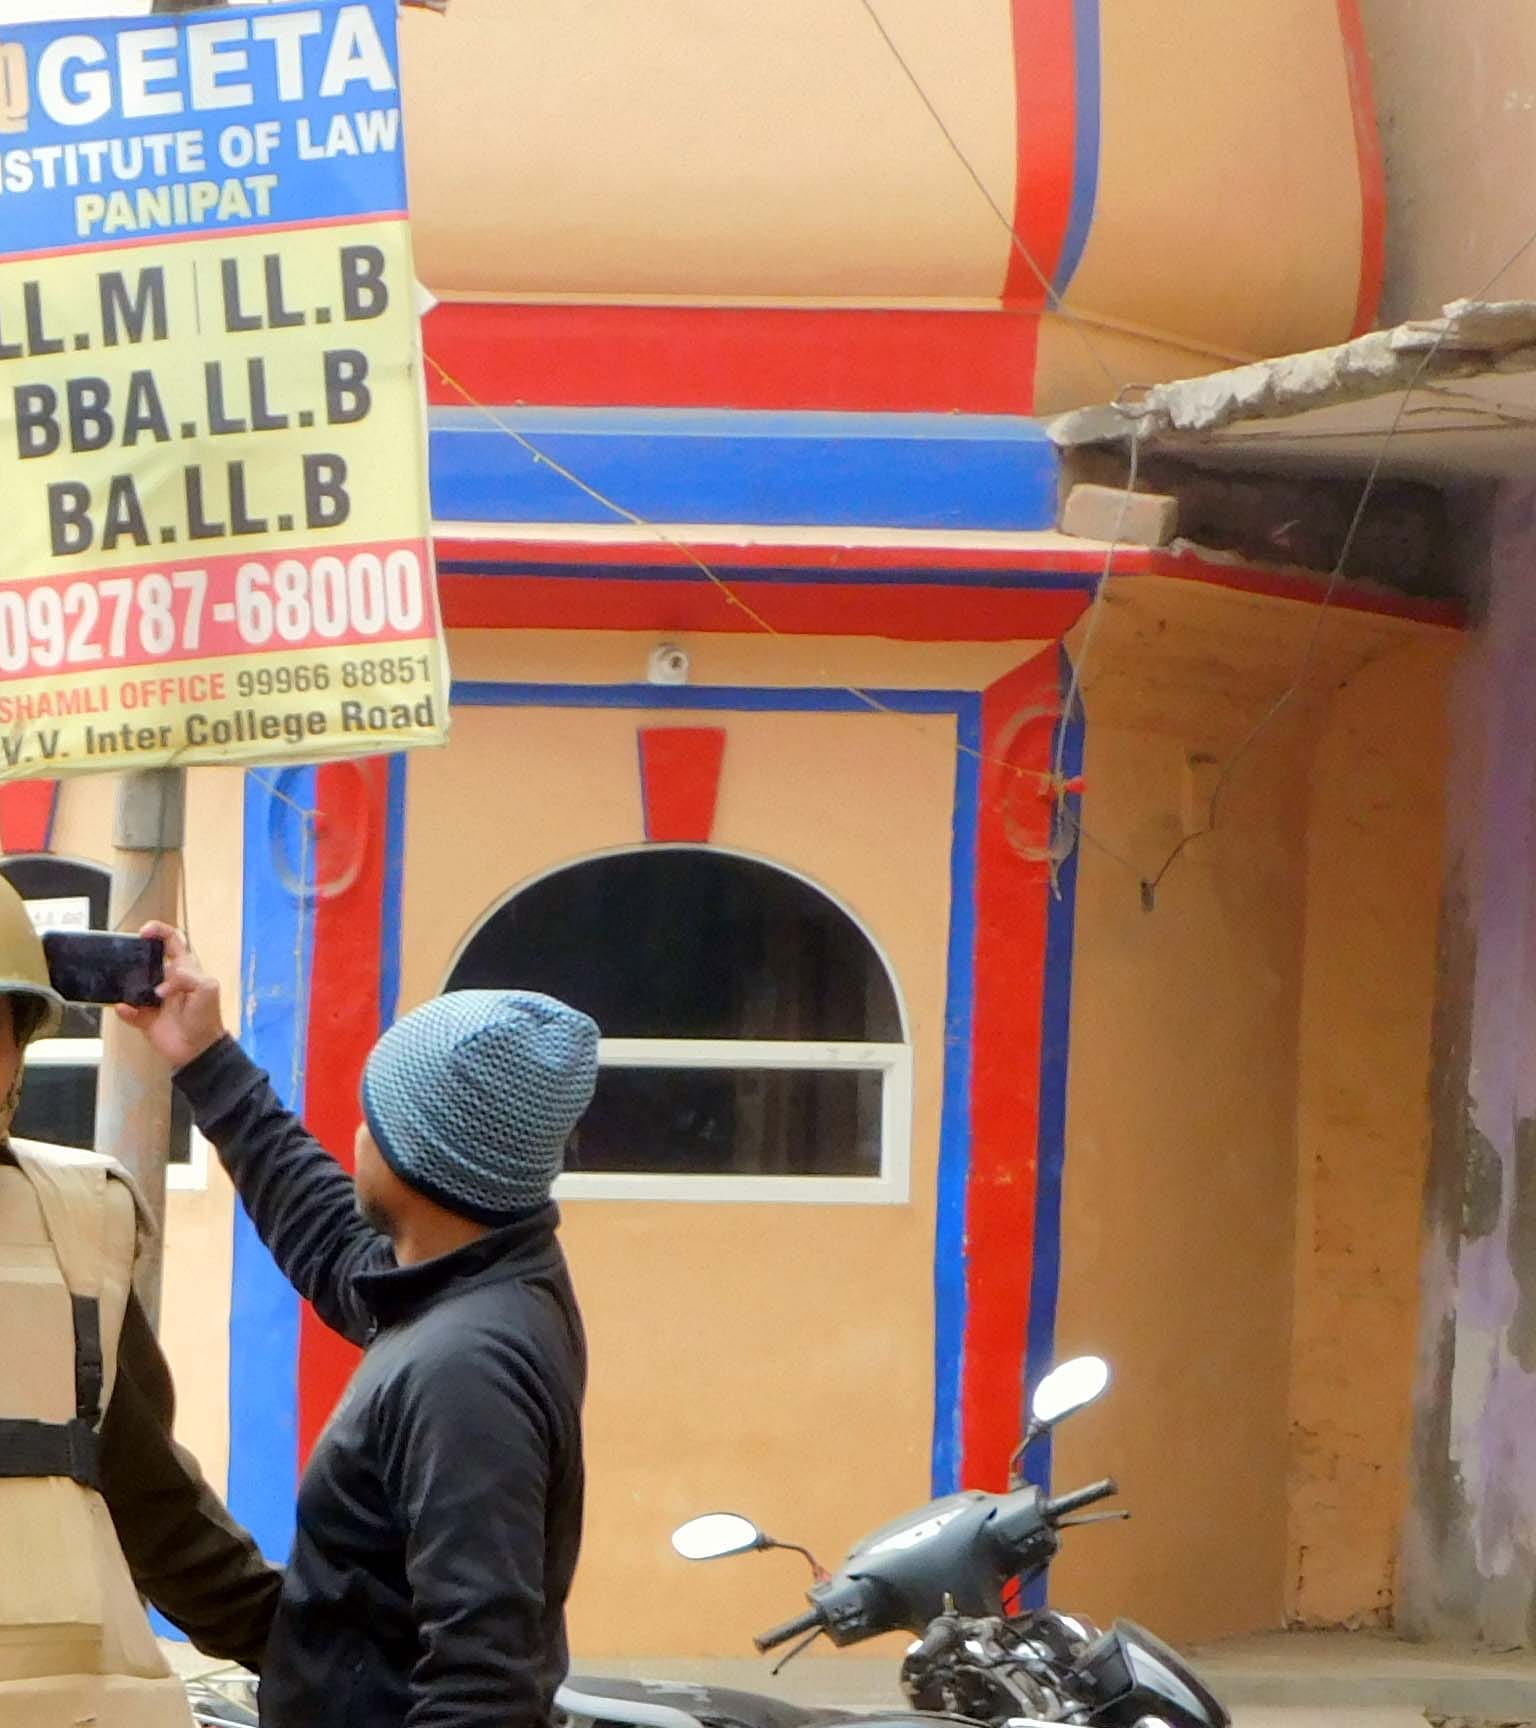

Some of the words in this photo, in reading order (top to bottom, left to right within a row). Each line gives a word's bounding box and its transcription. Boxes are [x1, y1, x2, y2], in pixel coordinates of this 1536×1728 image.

[37, 6, 397, 128] GEETA
[219, 121, 280, 164] OF
[296, 110, 400, 159] LAW
[75, 174, 278, 238] PANIPAT
[219, 245, 390, 334] LL.B
[13, 349, 373, 461] BBA.LL.B
[47, 452, 352, 557] BA.LL.B
[119, 672, 227, 711] OFFICE
[236, 663, 331, 699] 99966
[340, 655, 433, 689] 88851
[0, 732, 71, 768] V.V.
[84, 720, 172, 758] Inter
[184, 706, 328, 754] College
[340, 694, 435, 732] Road
